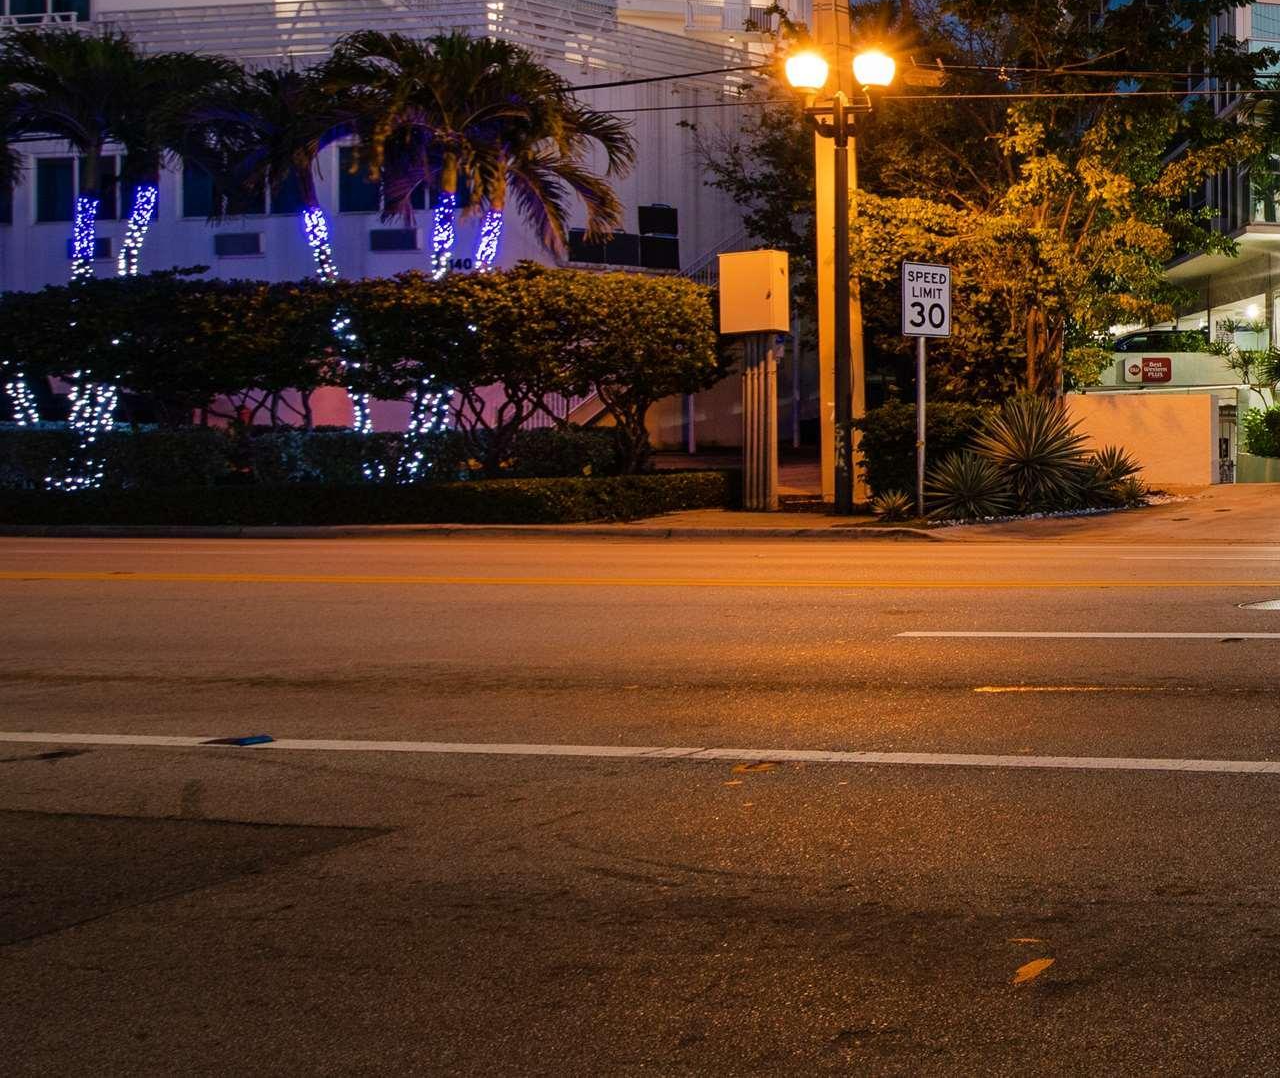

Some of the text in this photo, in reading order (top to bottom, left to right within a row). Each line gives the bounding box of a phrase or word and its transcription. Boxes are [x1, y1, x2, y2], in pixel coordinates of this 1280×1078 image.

[907, 270, 947, 284] SPEED
[912, 286, 943, 299] LIMIT
[910, 301, 945, 329] 30
